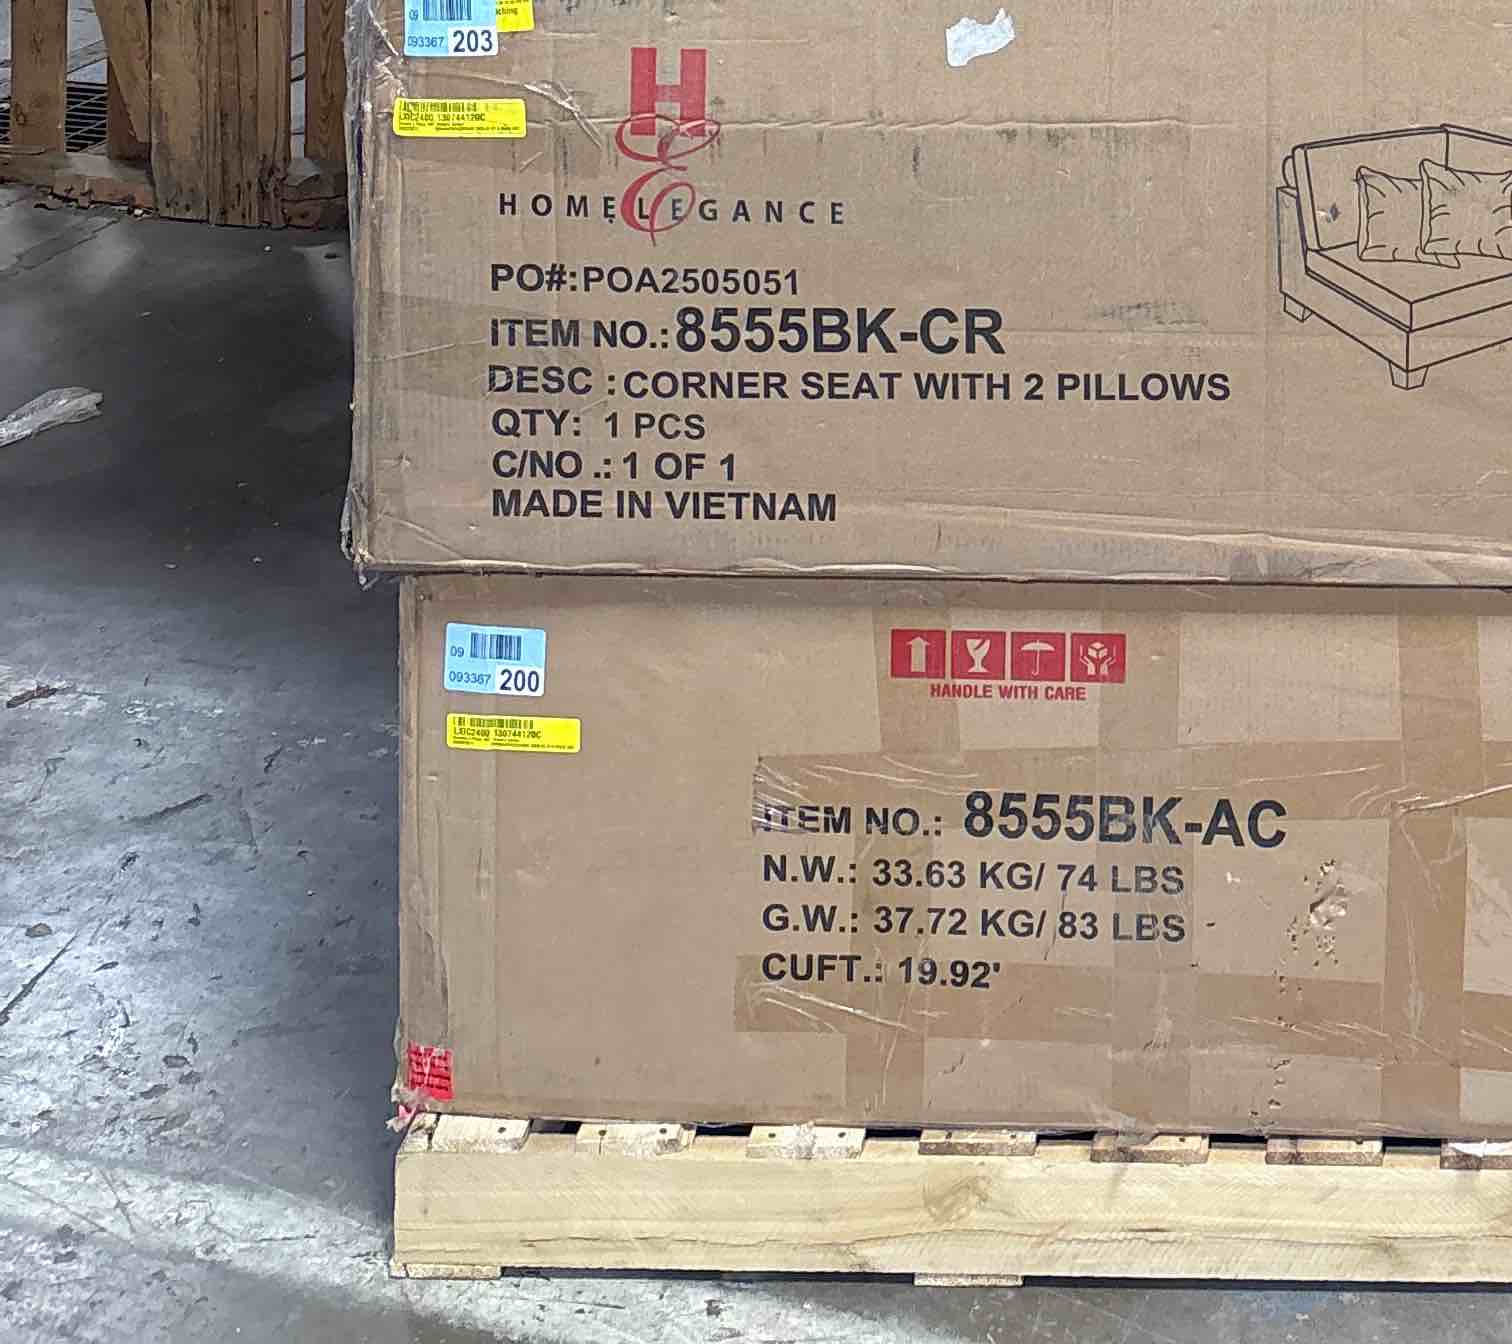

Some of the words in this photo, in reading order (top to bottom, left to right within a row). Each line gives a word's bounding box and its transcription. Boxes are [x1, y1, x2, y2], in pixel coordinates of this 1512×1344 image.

[453, 30, 493, 53] 203
[490, 318, 581, 350] ITEM
[487, 366, 593, 398] DESC
[801, 372, 901, 402] SEAT
[915, 372, 1012, 403] WITH
[1023, 372, 1044, 402] 2
[1056, 372, 1232, 403] PILLOWS
[491, 407, 582, 441] QTY:
[605, 413, 620, 440] 1
[634, 412, 706, 442] PCS
[491, 449, 583, 481] C/NO
[622, 453, 637, 480] 1
[654, 453, 706, 482] OF
[720, 454, 737, 482] 1
[491, 489, 602, 520] MADE
[616, 490, 652, 521] IN
[664, 490, 837, 522] VIETNAM
[450, 645, 465, 658] 09
[449, 670, 492, 686] 093367
[499, 668, 541, 693] 200
[929, 684, 994, 701] HANDLE
[998, 684, 1041, 700] WITH
[1043, 685, 1087, 702] CARE
[762, 805, 851, 836] ITEM
[865, 806, 943, 837] NO.:
[964, 790, 1288, 849] 8555BK-AC
[762, 855, 858, 885] N.W.:
[871, 857, 966, 890] 33.63
[978, 861, 1043, 893] KG/
[1056, 864, 1099, 893] 74
[1111, 864, 1185, 896] LBS
[762, 903, 859, 934] G.W.:
[872, 905, 968, 937] 37.72
[979, 908, 1044, 941] KG/
[1057, 910, 1099, 941] 83
[1112, 912, 1187, 944] LBS
[761, 952, 883, 984] CUFT.:
[898, 956, 1002, 991] 19.92'
